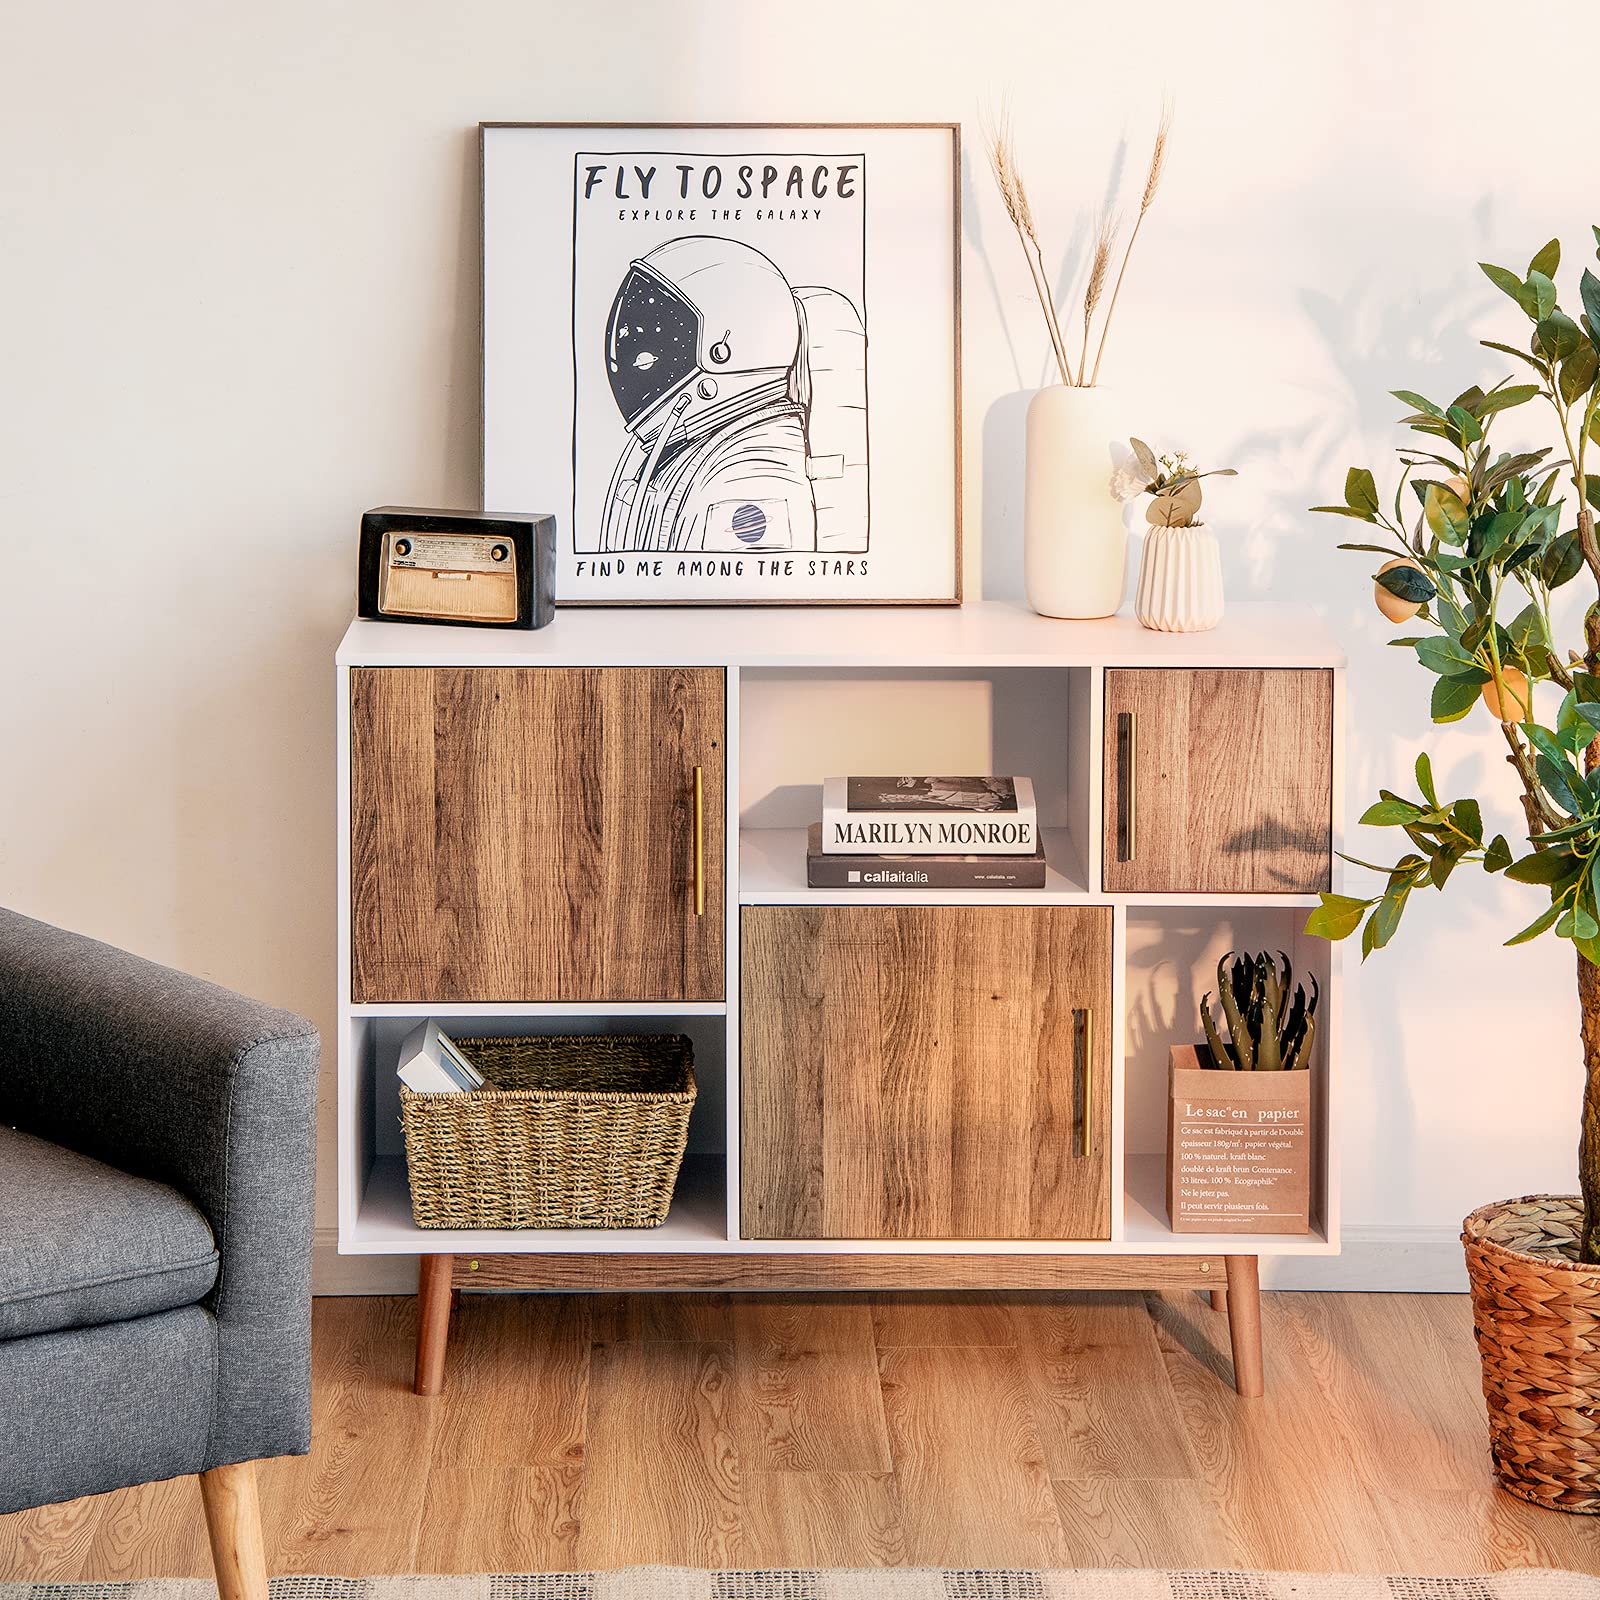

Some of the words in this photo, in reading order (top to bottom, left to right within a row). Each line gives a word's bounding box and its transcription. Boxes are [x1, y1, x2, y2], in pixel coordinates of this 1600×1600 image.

[584, 165, 656, 199] FLY
[675, 165, 722, 199] TO
[737, 165, 859, 199] SPACE
[619, 209, 697, 221] EXPLORE
[711, 209, 742, 221] THE
[756, 209, 822, 221] GALAXY
[576, 559, 625, 576] FIND
[636, 560, 664, 576] ME
[677, 560, 744, 576] AMONG
[757, 560, 794, 576] THE
[808, 560, 869, 576] STARS
[835, 823, 932, 844] MARILYN
[938, 823, 1031, 844] MONROE
[864, 871, 929, 883] caliaitalia
[1186, 1104, 1203, 1117] Le
[1232, 1110, 1248, 1118] en
[1258, 1108, 1299, 1122] papier
[1214, 1127, 1243, 1136] fabriqué
[1249, 1129, 1268, 1137] partir
[1181, 1140, 1211, 1149] épaisseur
[1200, 1190, 1216, 1198] jetez
[1224, 1203, 1254, 1211] plusieurs
